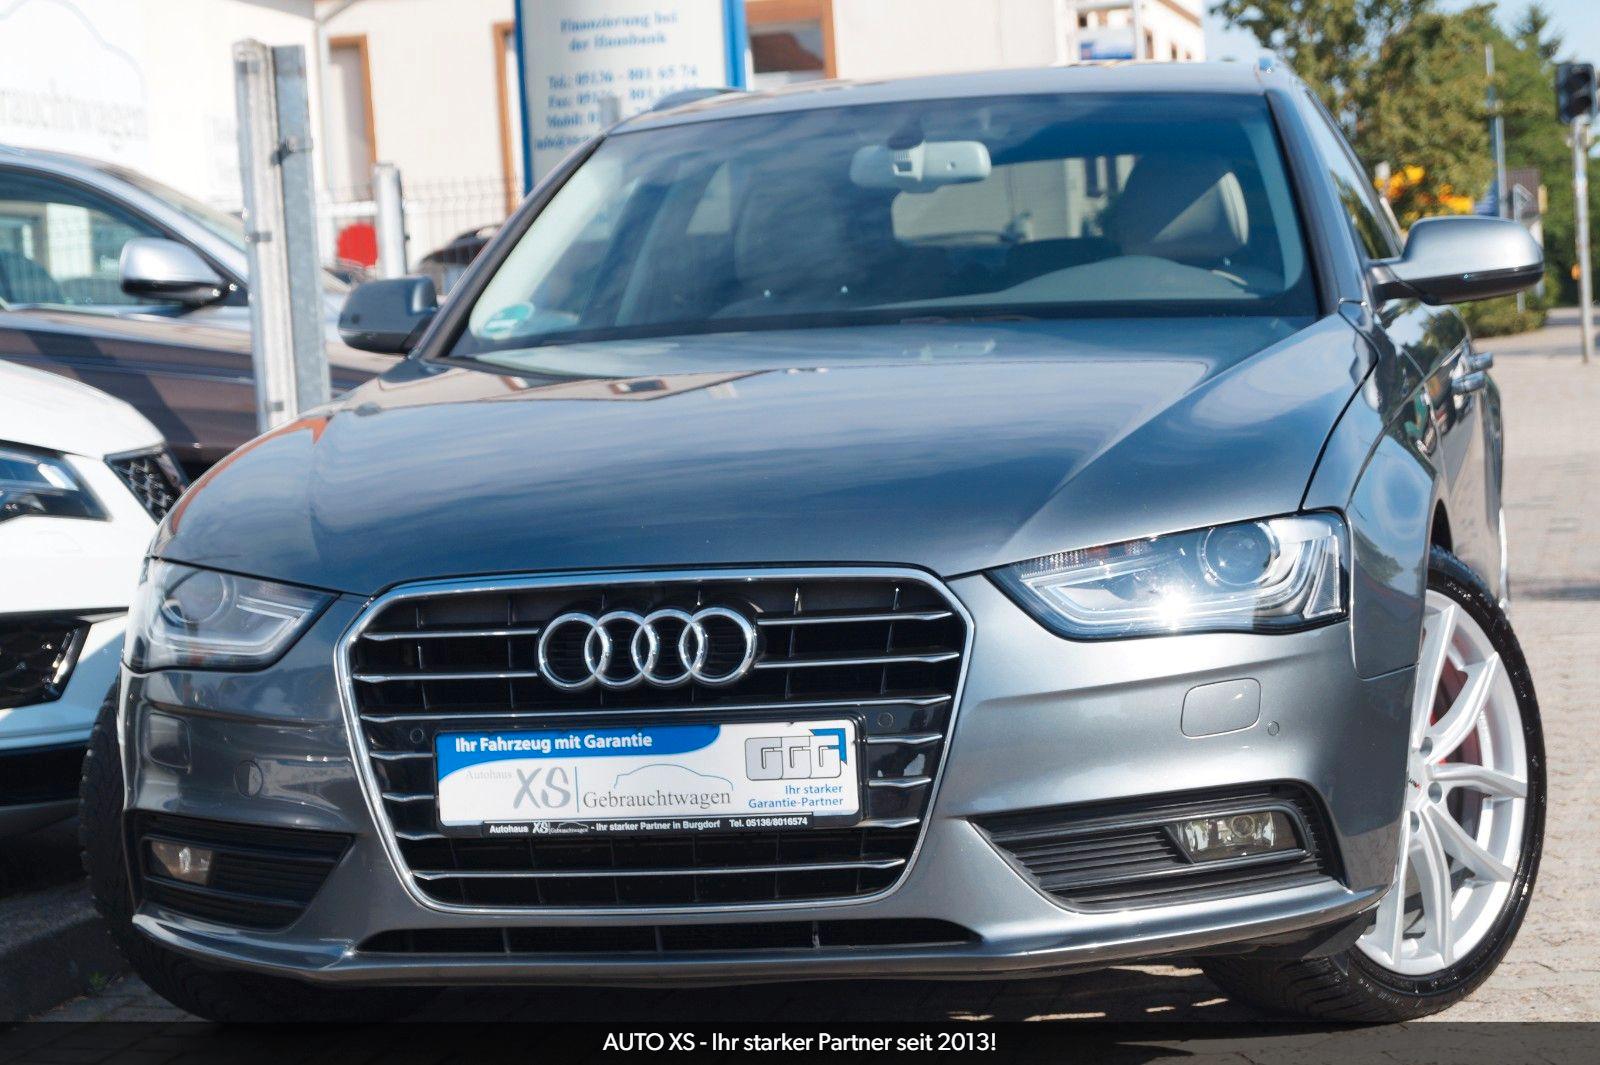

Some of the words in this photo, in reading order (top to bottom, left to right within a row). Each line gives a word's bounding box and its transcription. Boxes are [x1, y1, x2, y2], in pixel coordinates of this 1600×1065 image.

[560, 15, 650, 32] Finanzierung
[455, 737, 478, 752] Ihr
[480, 736, 551, 753] Fahrzeug
[554, 735, 581, 749] mit
[584, 733, 653, 748] Garantie
[465, 770, 513, 781] Autohaus
[513, 766, 571, 810] XS
[583, 790, 731, 810] Gebrauchtwagen
[785, 785, 800, 795] Ihr
[804, 784, 843, 795] starker
[749, 797, 844, 809] Garantie-Partner
[489, 825, 529, 834] Autohaus
[596, 823, 608, 831] Ihr
[609, 823, 638, 831] starker
[640, 821, 670, 830] Partner
[683, 820, 720, 830] Burgdorf
[729, 819, 745, 827] Tel.
